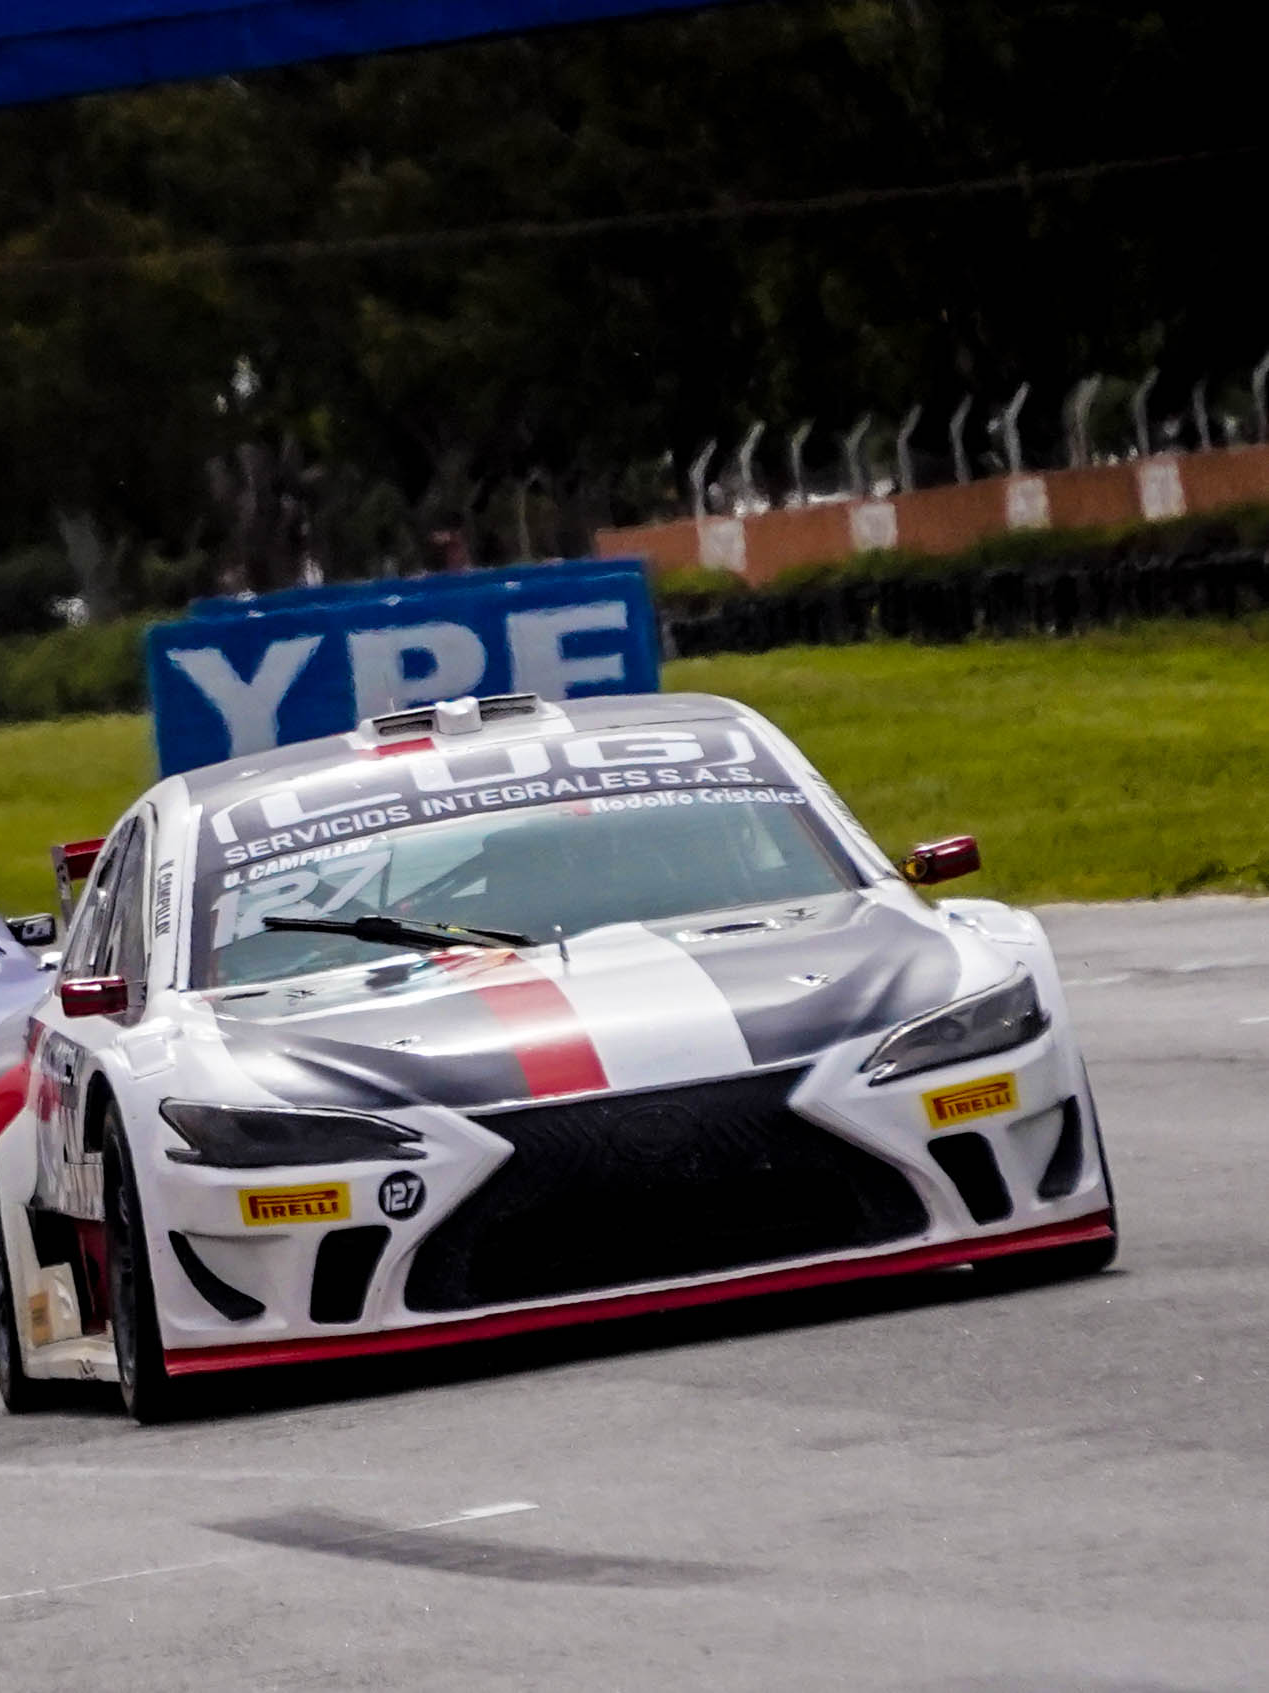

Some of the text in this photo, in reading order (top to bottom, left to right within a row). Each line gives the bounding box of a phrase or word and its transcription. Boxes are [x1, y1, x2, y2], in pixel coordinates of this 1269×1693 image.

[166, 600, 629, 759] YPF
[224, 766, 764, 865] SERVICIOS INTEGRALES S.A.S.
[590, 786, 807, 814] Rodolfo Cristales
[248, 838, 375, 881] CAMPILLAY
[210, 849, 392, 951] 127
[932, 1082, 1012, 1121] PIRELLI
[247, 1189, 340, 1220] PIRELLI
[383, 1179, 422, 1213] 127
